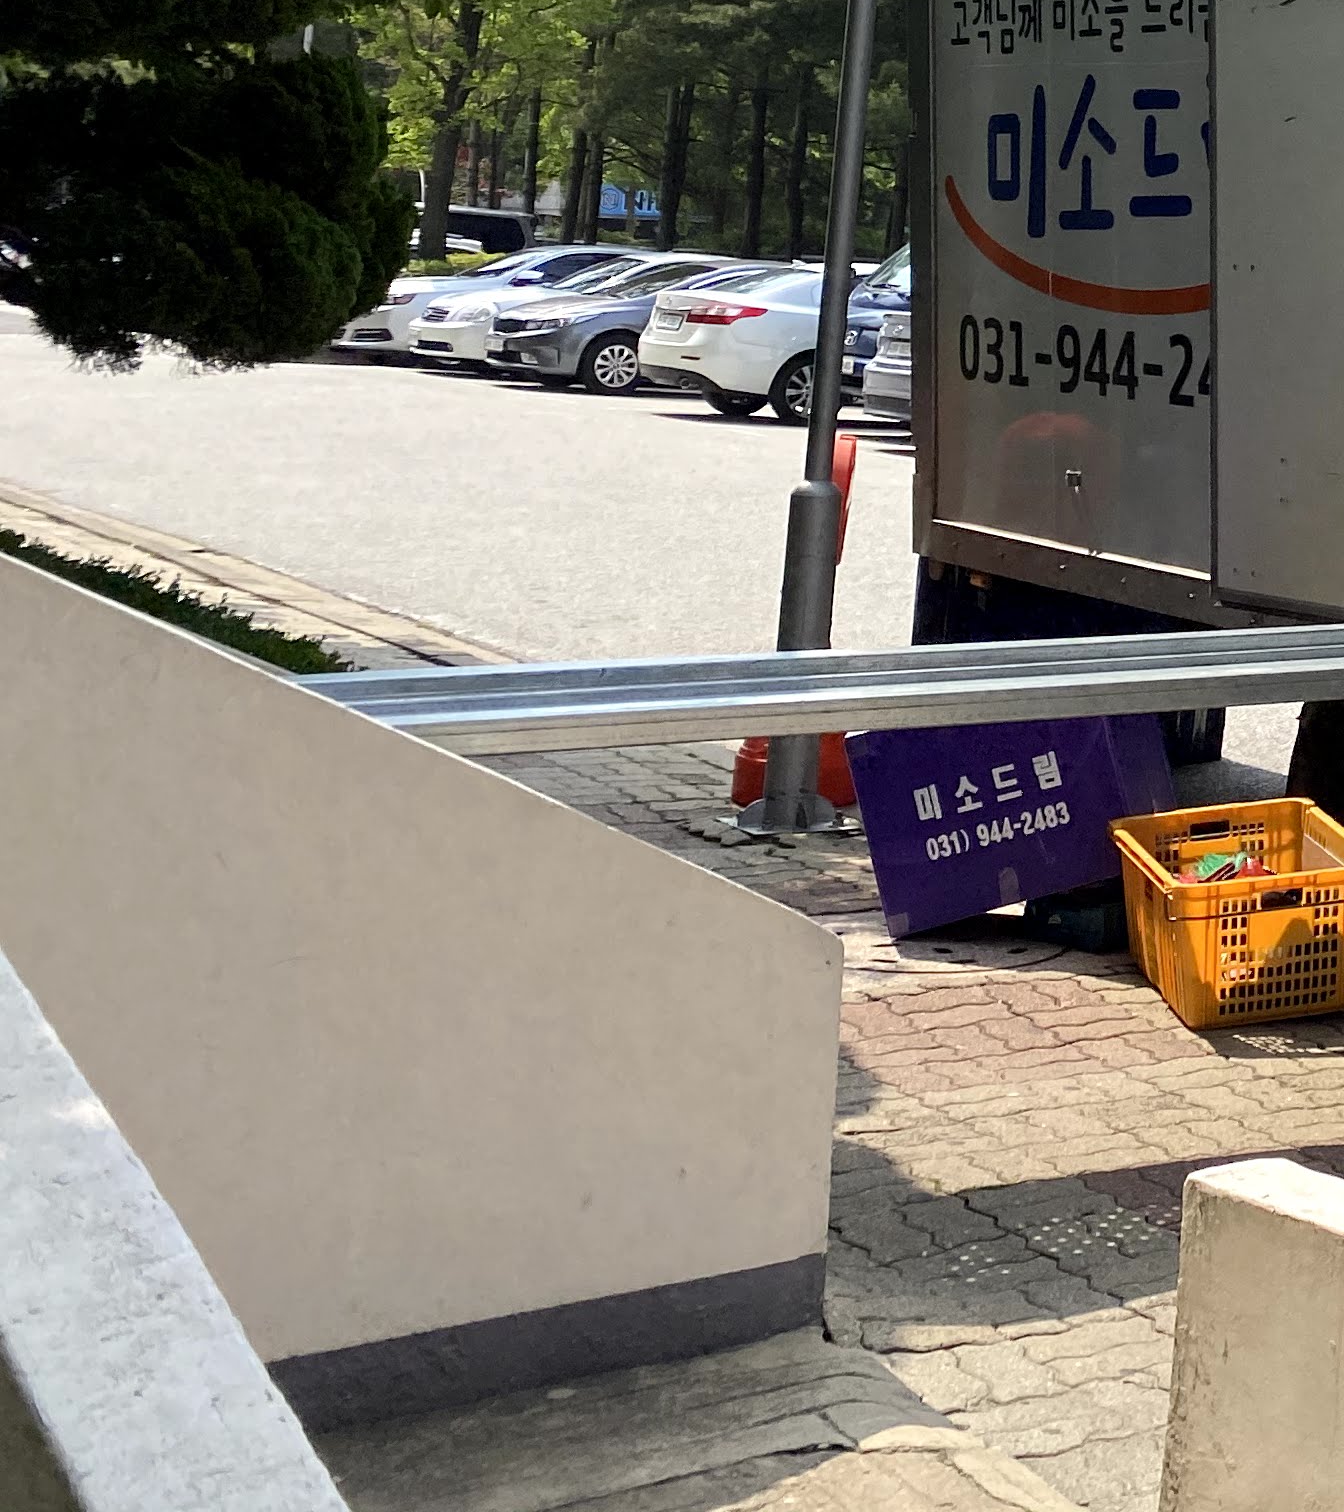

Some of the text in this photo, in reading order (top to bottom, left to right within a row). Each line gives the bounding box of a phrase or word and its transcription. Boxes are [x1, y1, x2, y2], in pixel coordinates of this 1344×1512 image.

[987, 74, 1209, 239] 미소드
[913, 750, 1063, 821] 미소드림
[925, 801, 1071, 861] 031) 944-2483
